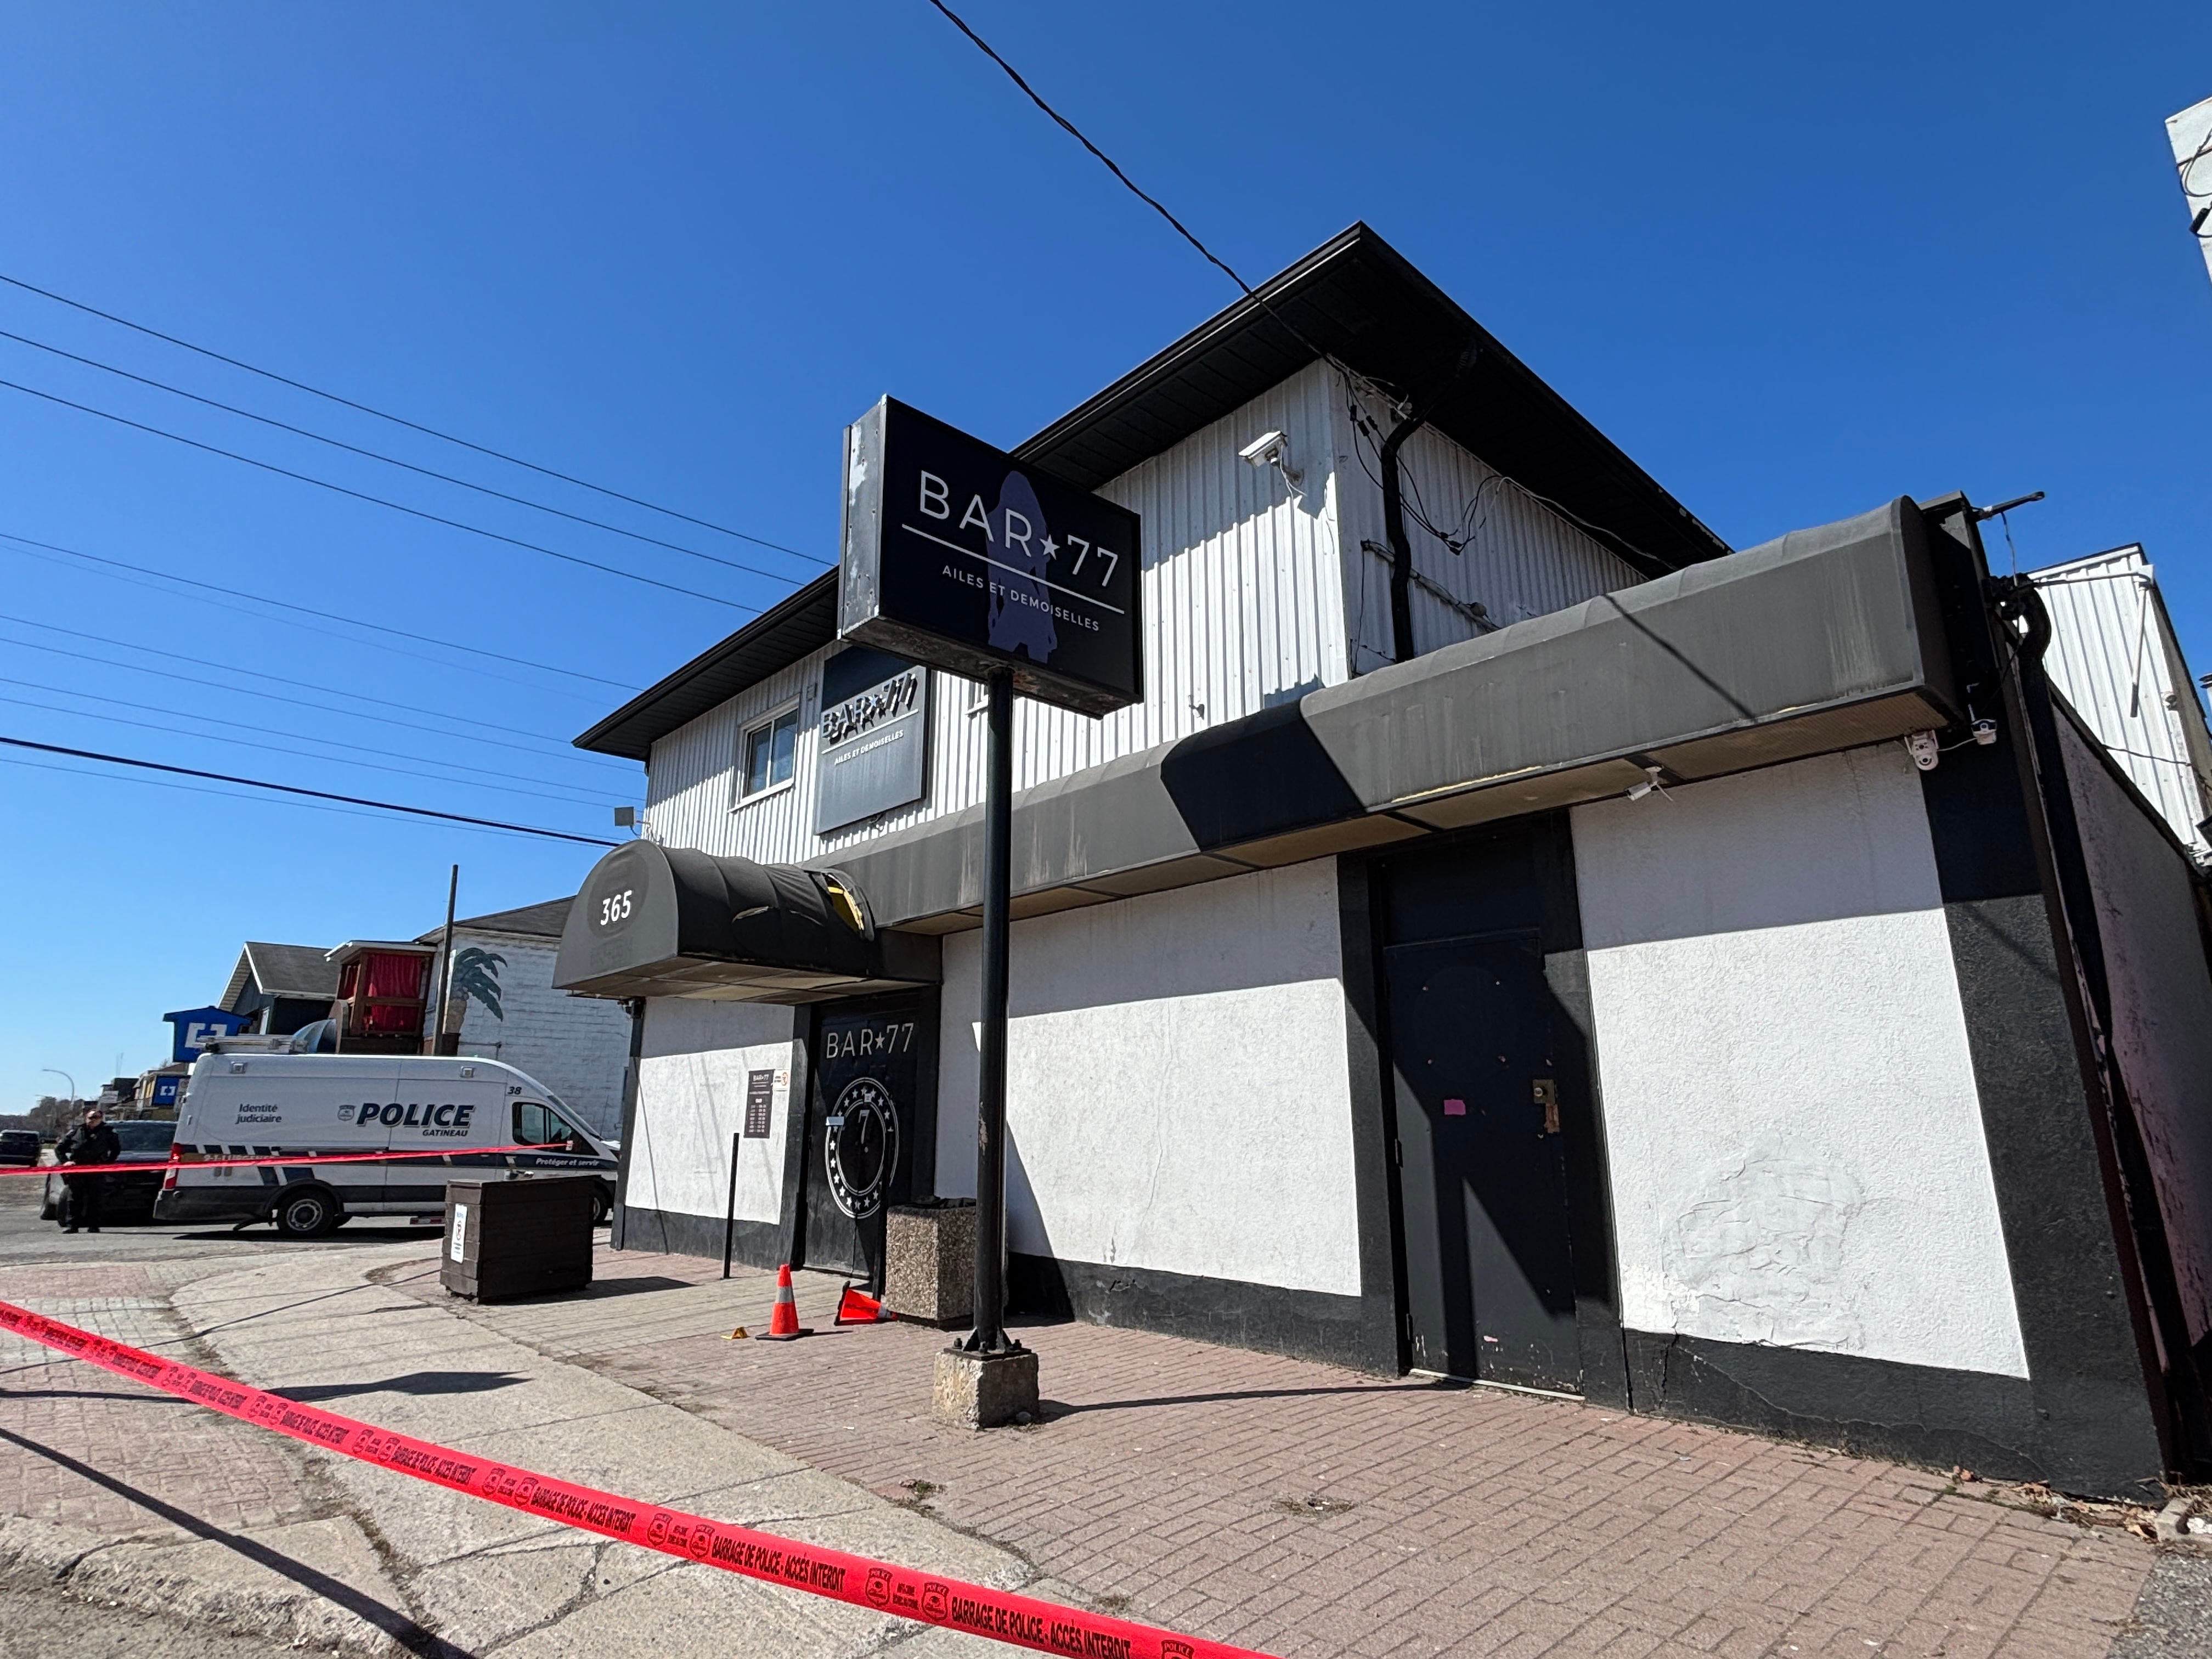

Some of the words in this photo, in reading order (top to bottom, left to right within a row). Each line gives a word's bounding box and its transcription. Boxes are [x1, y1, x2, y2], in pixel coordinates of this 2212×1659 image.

[920, 470, 1031, 557] BAR
[1068, 534, 1118, 587] 77
[942, 565, 984, 589] AILES
[989, 582, 1006, 596] ET
[1011, 590, 1099, 631] DEMOISELLES
[821, 696, 867, 738] BAR
[834, 752, 851, 766] AILES
[851, 748, 860, 758] ET
[860, 730, 905, 754] DEMOISELLES
[600, 890, 633, 926] 365
[826, 1028, 873, 1059] BAR
[885, 1023, 915, 1054] 77
[239, 1103, 278, 1113] Identité
[507, 1086, 522, 1095] 38
[235, 1114, 282, 1125] judiciaire
[357, 1103, 475, 1128] POLICE
[535, 1158, 568, 1166] Protéger
[711, 1535, 746, 1566] BARRAGE
[744, 1544, 757, 1569] DE
[754, 1546, 782, 1576] POLICE
[809, 1561, 846, 1593] INTERDIT
[952, 1596, 994, 1632] BARRAGE
[995, 1606, 1008, 1634] DE
[1009, 1611, 1044, 1644] POLICE
[1084, 1629, 1131, 1659] INTERDIT
